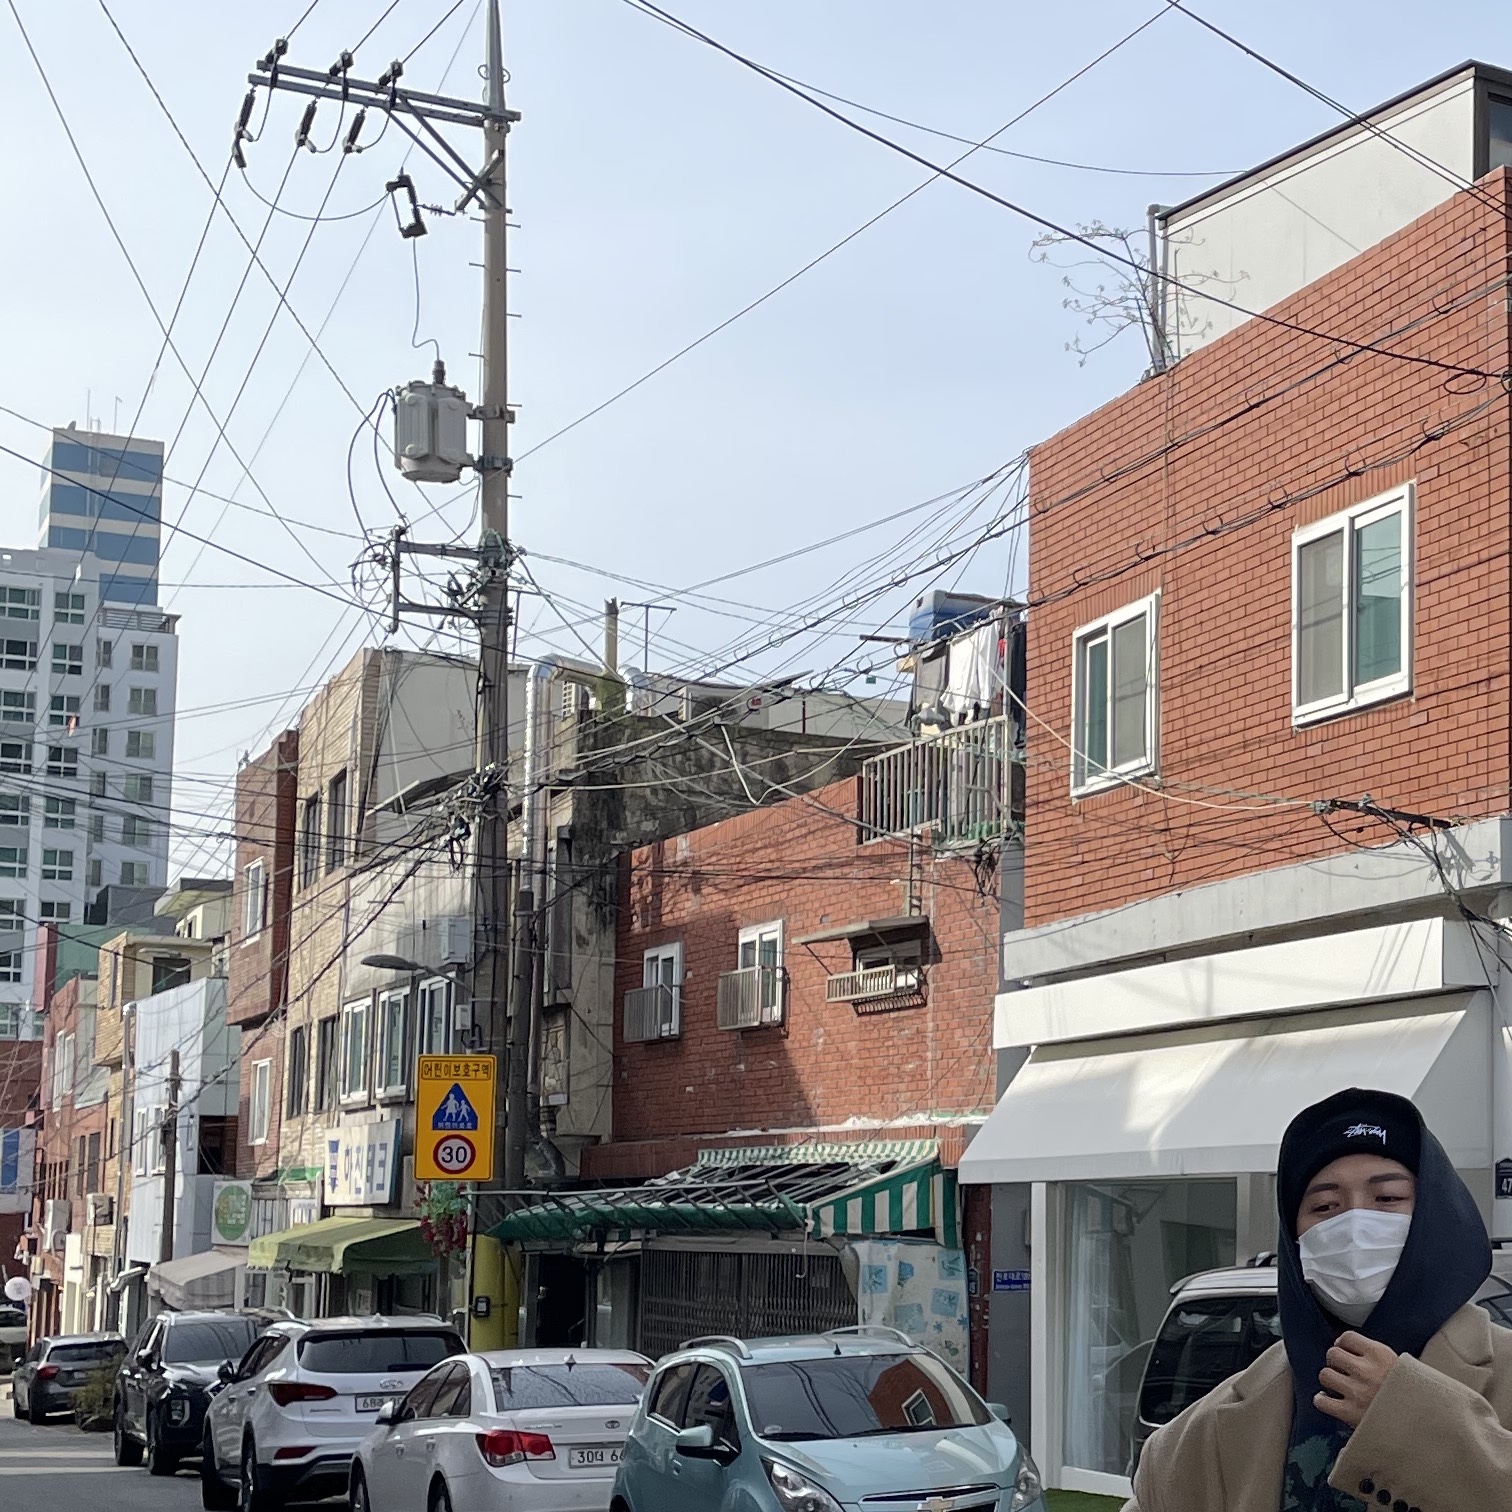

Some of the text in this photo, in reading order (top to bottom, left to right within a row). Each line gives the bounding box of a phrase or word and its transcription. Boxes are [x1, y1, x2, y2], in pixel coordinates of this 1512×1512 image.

[423, 1062, 490, 1078] 어린이보호구역
[441, 1146, 468, 1164] 30
[1501, 1177, 1512, 1193] 47
